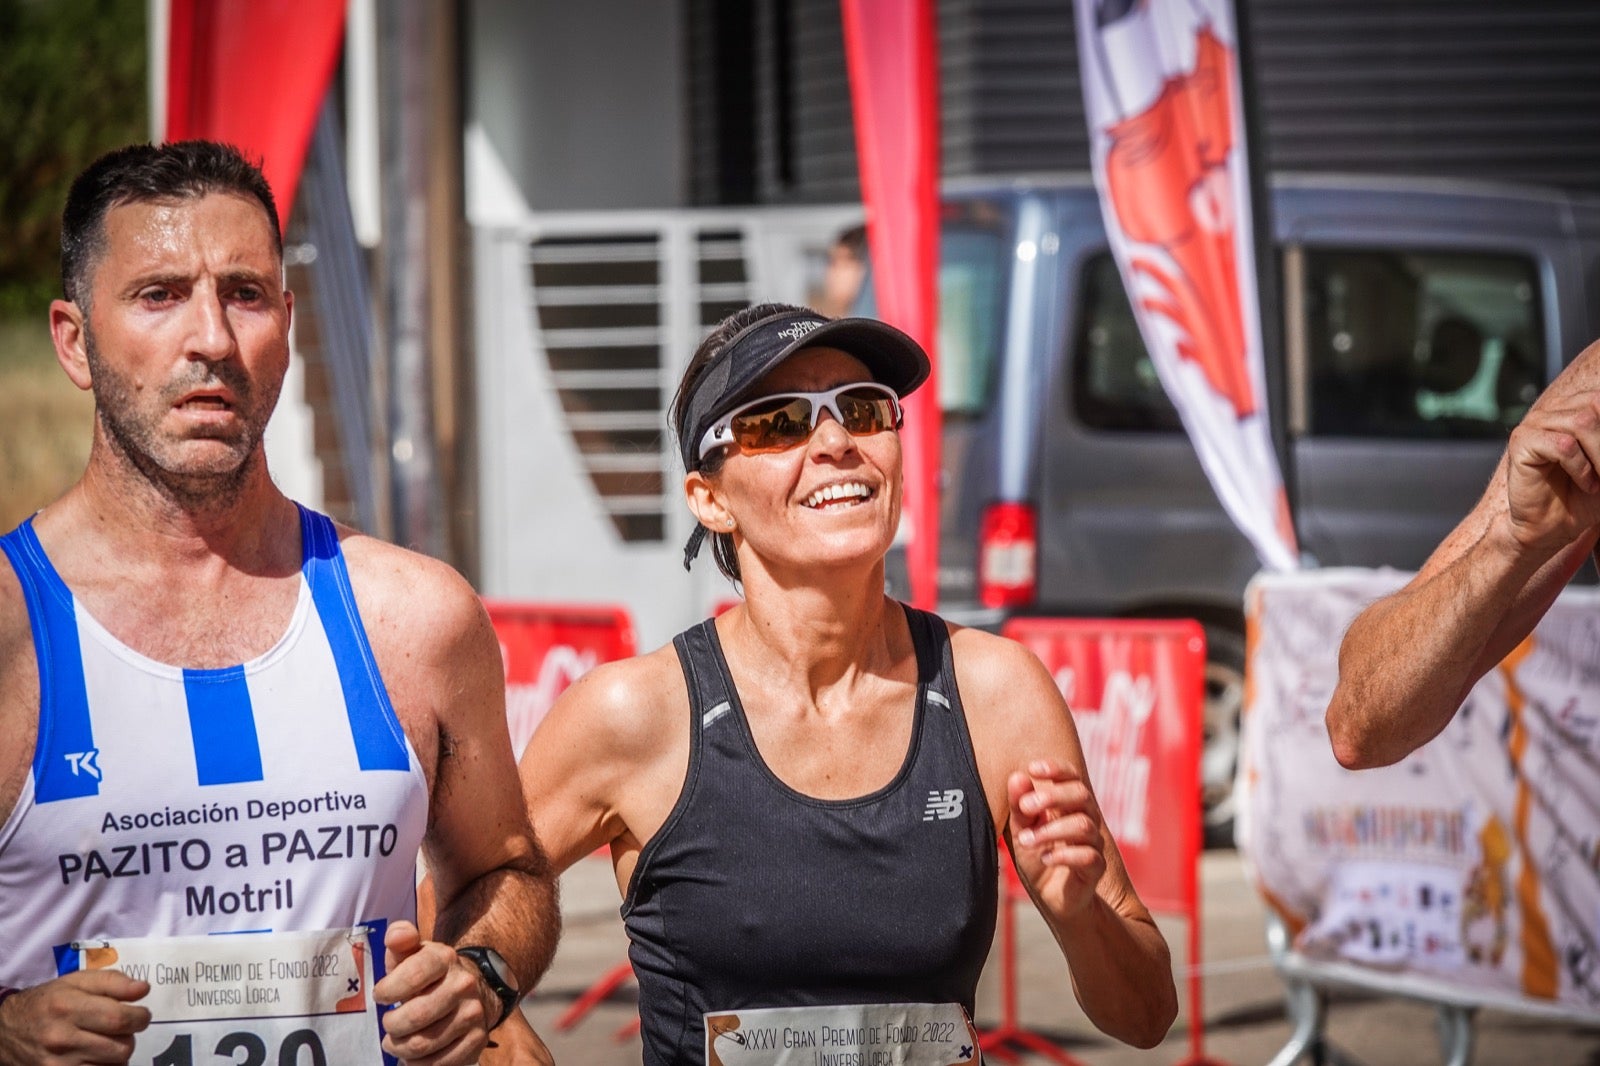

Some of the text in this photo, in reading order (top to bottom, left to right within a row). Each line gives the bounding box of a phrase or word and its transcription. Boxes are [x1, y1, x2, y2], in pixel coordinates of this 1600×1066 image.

[101, 791, 367, 833] Asociación Deportiva
[58, 823, 398, 885] PAZITO a PAZITO
[186, 878, 293, 917] Motril
[156, 963, 189, 985] GRAN
[195, 960, 242, 983] PREMIO
[248, 962, 264, 981] DE
[269, 958, 309, 980] FONDO
[312, 954, 339, 978] 2022
[187, 985, 280, 1007] UNIVERSO LORCA
[743, 1022, 955, 1051] XXXV GRAN PREMIO DE FONDO 2022
